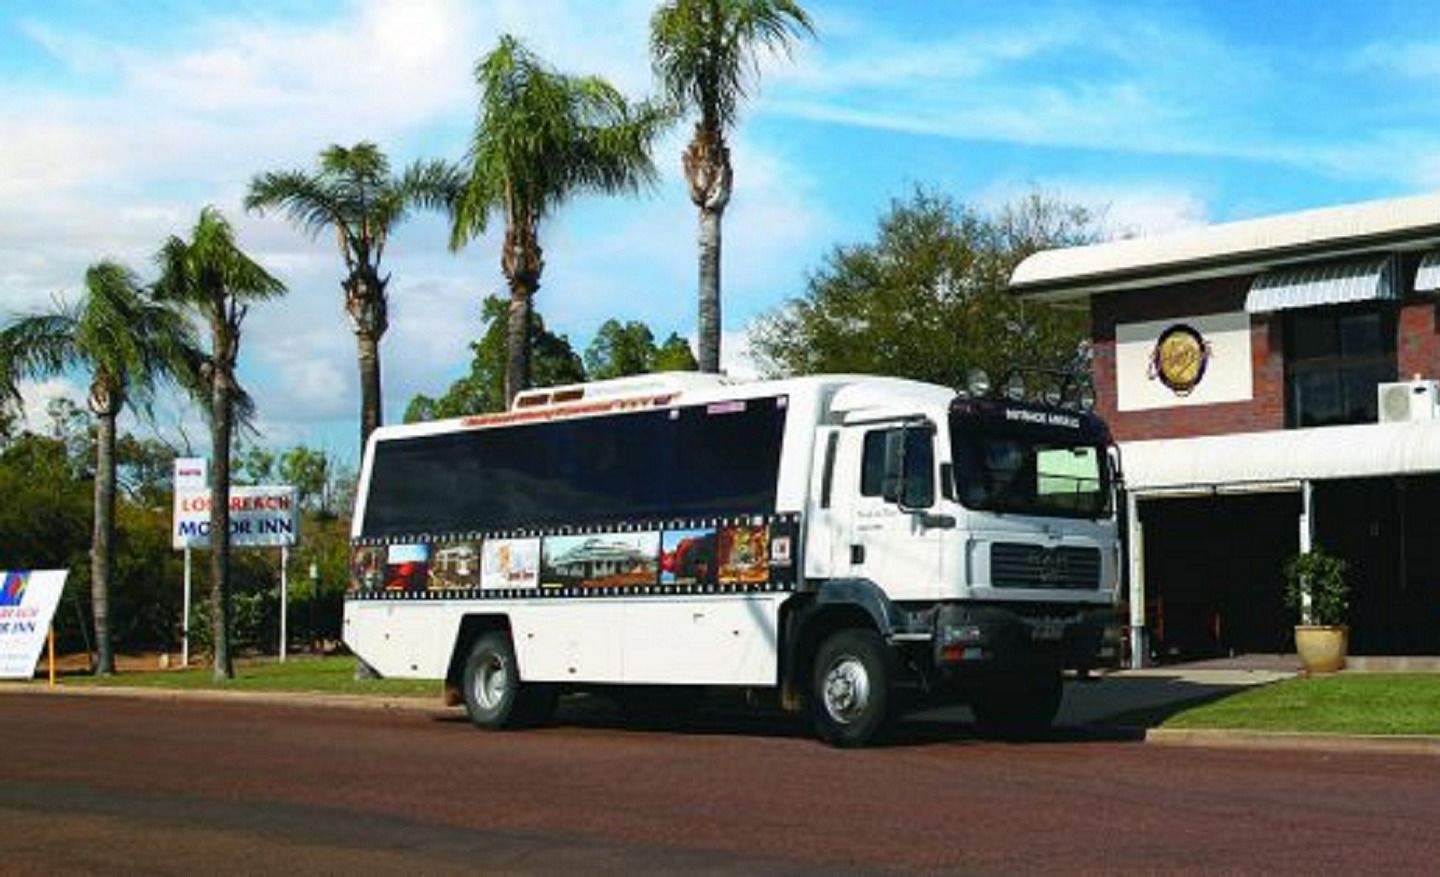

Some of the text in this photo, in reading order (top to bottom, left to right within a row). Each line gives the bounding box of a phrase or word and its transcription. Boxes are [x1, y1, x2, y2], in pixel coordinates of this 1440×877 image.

[181, 495, 291, 513] LOREACH
[178, 518, 294, 537] MOOR INN
